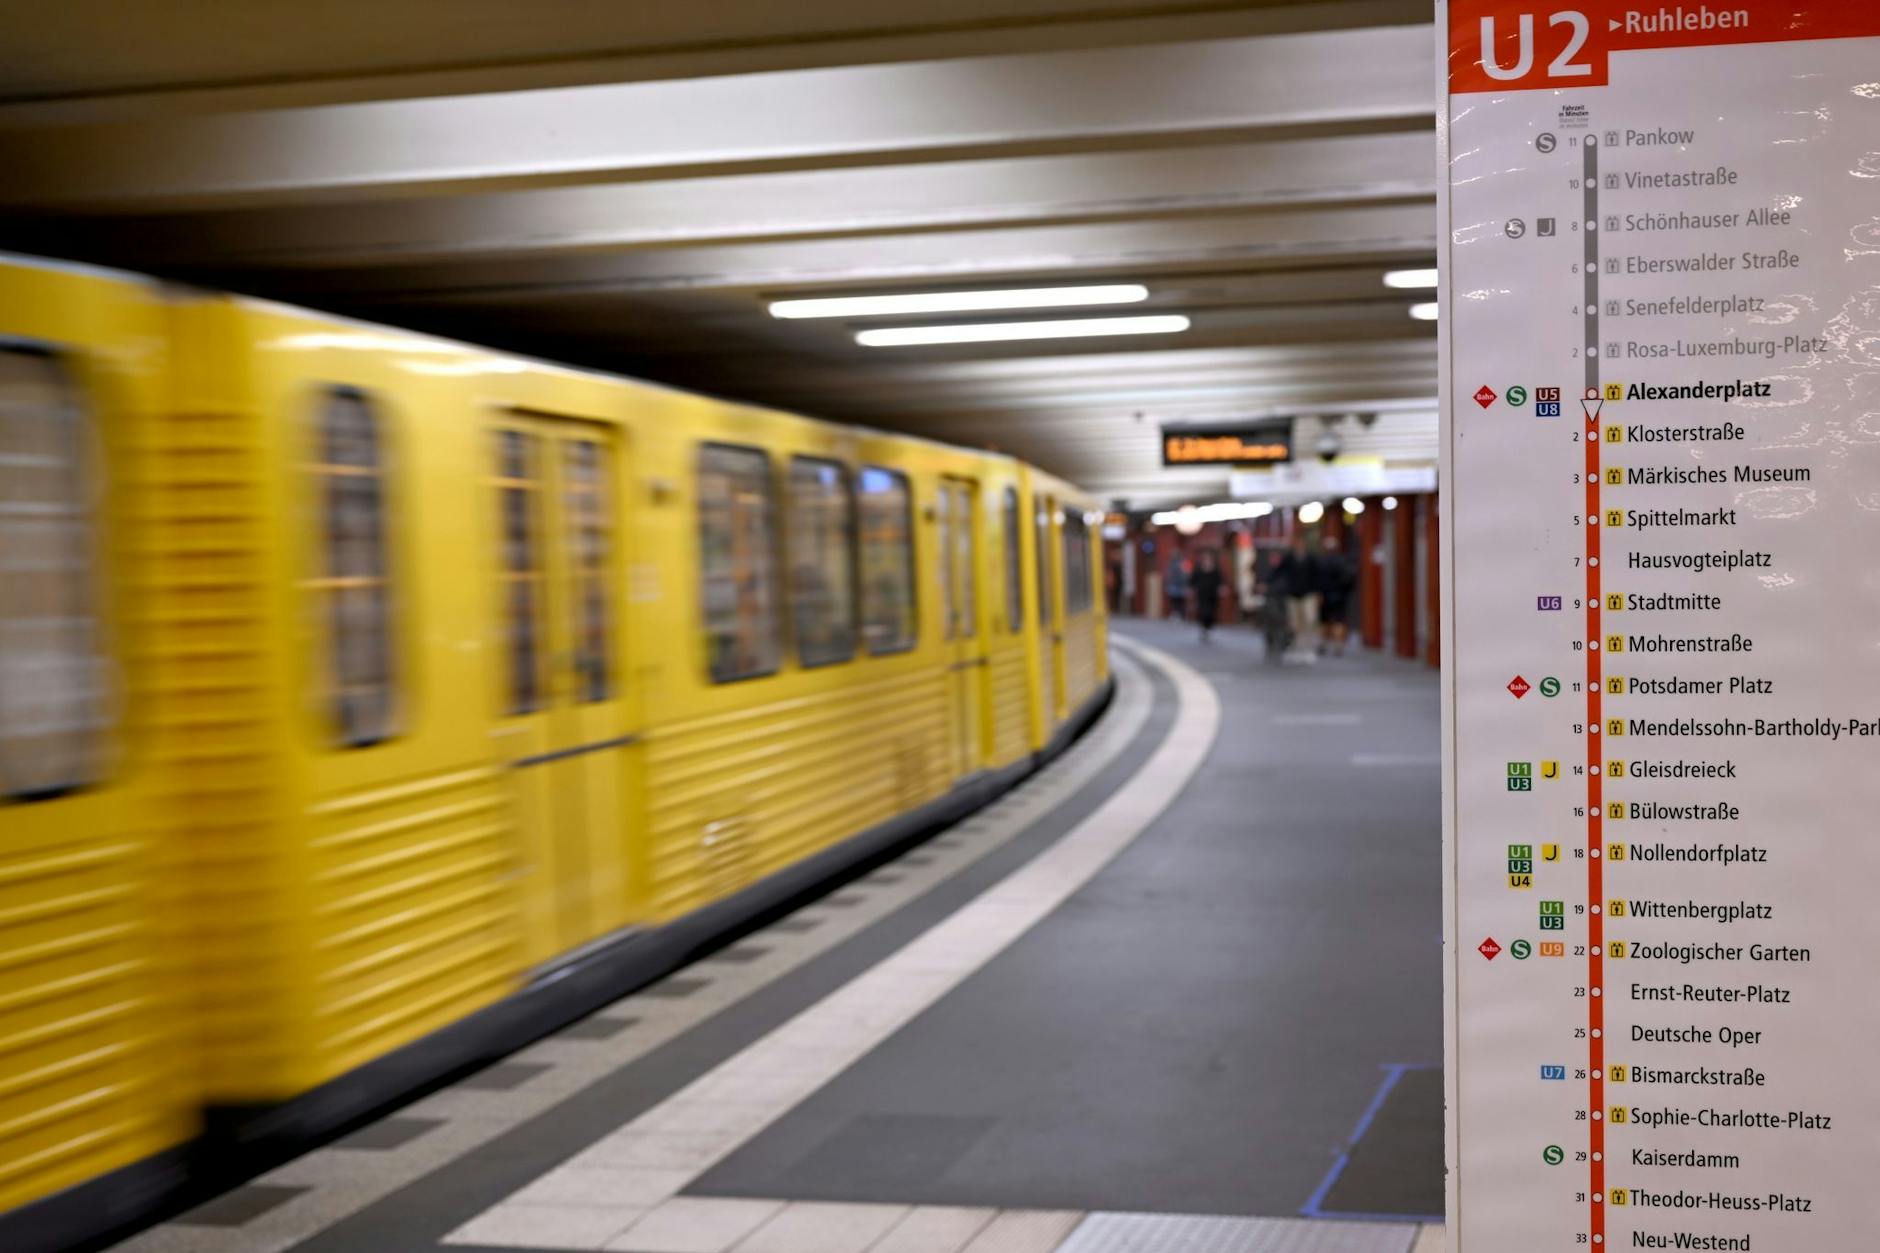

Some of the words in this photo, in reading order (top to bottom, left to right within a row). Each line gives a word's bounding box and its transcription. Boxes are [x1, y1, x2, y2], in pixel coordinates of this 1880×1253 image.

[1626, 6, 1748, 33] Ruhleben
[1479, 11, 1591, 80] U2
[1568, 137, 1577, 147] 11
[1627, 128, 1694, 145] Pankow
[1569, 179, 1580, 190] 10
[1625, 167, 1737, 188] Vinetastraße
[1571, 221, 1578, 232] 8
[1626, 212, 1739, 231] Schönhauser
[1746, 208, 1790, 225] Allee
[1571, 263, 1578, 274] 6
[1627, 253, 1735, 273] Eberswalder
[1743, 250, 1799, 269] Straße
[1572, 305, 1579, 316] 4
[1627, 295, 1764, 317] Senefelderplatz
[1572, 347, 1579, 359] 2
[1628, 335, 1827, 358] Rosa-Luxemburg-Platz
[1538, 388, 1558, 401] U5
[1627, 380, 1771, 402] Alexanderplatz
[1538, 403, 1558, 416] U8
[1573, 431, 1579, 442] 2
[1628, 423, 1744, 442] Klosterstraße
[1573, 473, 1580, 484] 3
[1629, 466, 1726, 484] Märkisches
[1735, 466, 1809, 482] Museum
[1573, 515, 1580, 526] 5
[1628, 508, 1736, 530] Spittelmarkt
[1574, 557, 1580, 568] 7
[1629, 550, 1771, 572] Hausvogteiplatz
[1541, 598, 1560, 609] U6
[1574, 599, 1581, 609] 9
[1629, 593, 1720, 610] Stadtmitte
[1572, 640, 1583, 651] 10
[1630, 634, 1752, 652] Mohrenstraße
[1572, 682, 1581, 692] 11
[1630, 677, 1722, 694] Potsdamer
[1730, 676, 1772, 693] Platz
[1573, 724, 1583, 734] 13
[1510, 763, 1528, 776] U1
[1573, 765, 1583, 776] 14
[1631, 760, 1735, 777] Gleisdreieck
[1510, 778, 1530, 790] U3
[1574, 807, 1584, 817] 16
[1631, 802, 1738, 820] Bülowstraße
[1510, 846, 1529, 858] U1
[1574, 848, 1584, 858] 18
[1631, 844, 1766, 866] Nollendorfplatz
[1510, 860, 1530, 873] U3
[1511, 875, 1531, 887] U4
[1542, 902, 1561, 914] U1
[1574, 904, 1584, 915] 19
[1630, 901, 1771, 923] Wittenbergplatz
[1542, 917, 1562, 930] U3
[1543, 944, 1562, 956] U9
[1573, 945, 1585, 956] 22
[1631, 942, 1743, 964] Zoologischer
[1750, 945, 1809, 961] Garten
[1574, 987, 1585, 997] 23
[1632, 984, 1790, 1002] Ernst-Reuter-Platz
[1574, 1028, 1586, 1038] 25
[1632, 1026, 1711, 1042] Deutsche
[1719, 1027, 1761, 1048] Oper
[1544, 1068, 1563, 1079] U7
[1575, 1069, 1586, 1079] 26
[1632, 1067, 1764, 1085] Bismarckstraße
[1575, 1110, 1586, 1121] 28
[1632, 1108, 1830, 1129] Sophie-Charlotte-Platz
[1575, 1151, 1587, 1162] 29
[1633, 1149, 1738, 1168] Kaiserdamm
[1576, 1192, 1585, 1202] 31
[1630, 1189, 1811, 1212] Theodor-Heuss-Platz
[1576, 1233, 1587, 1243] 33
[1634, 1231, 1749, 1251] Neu-Westend
